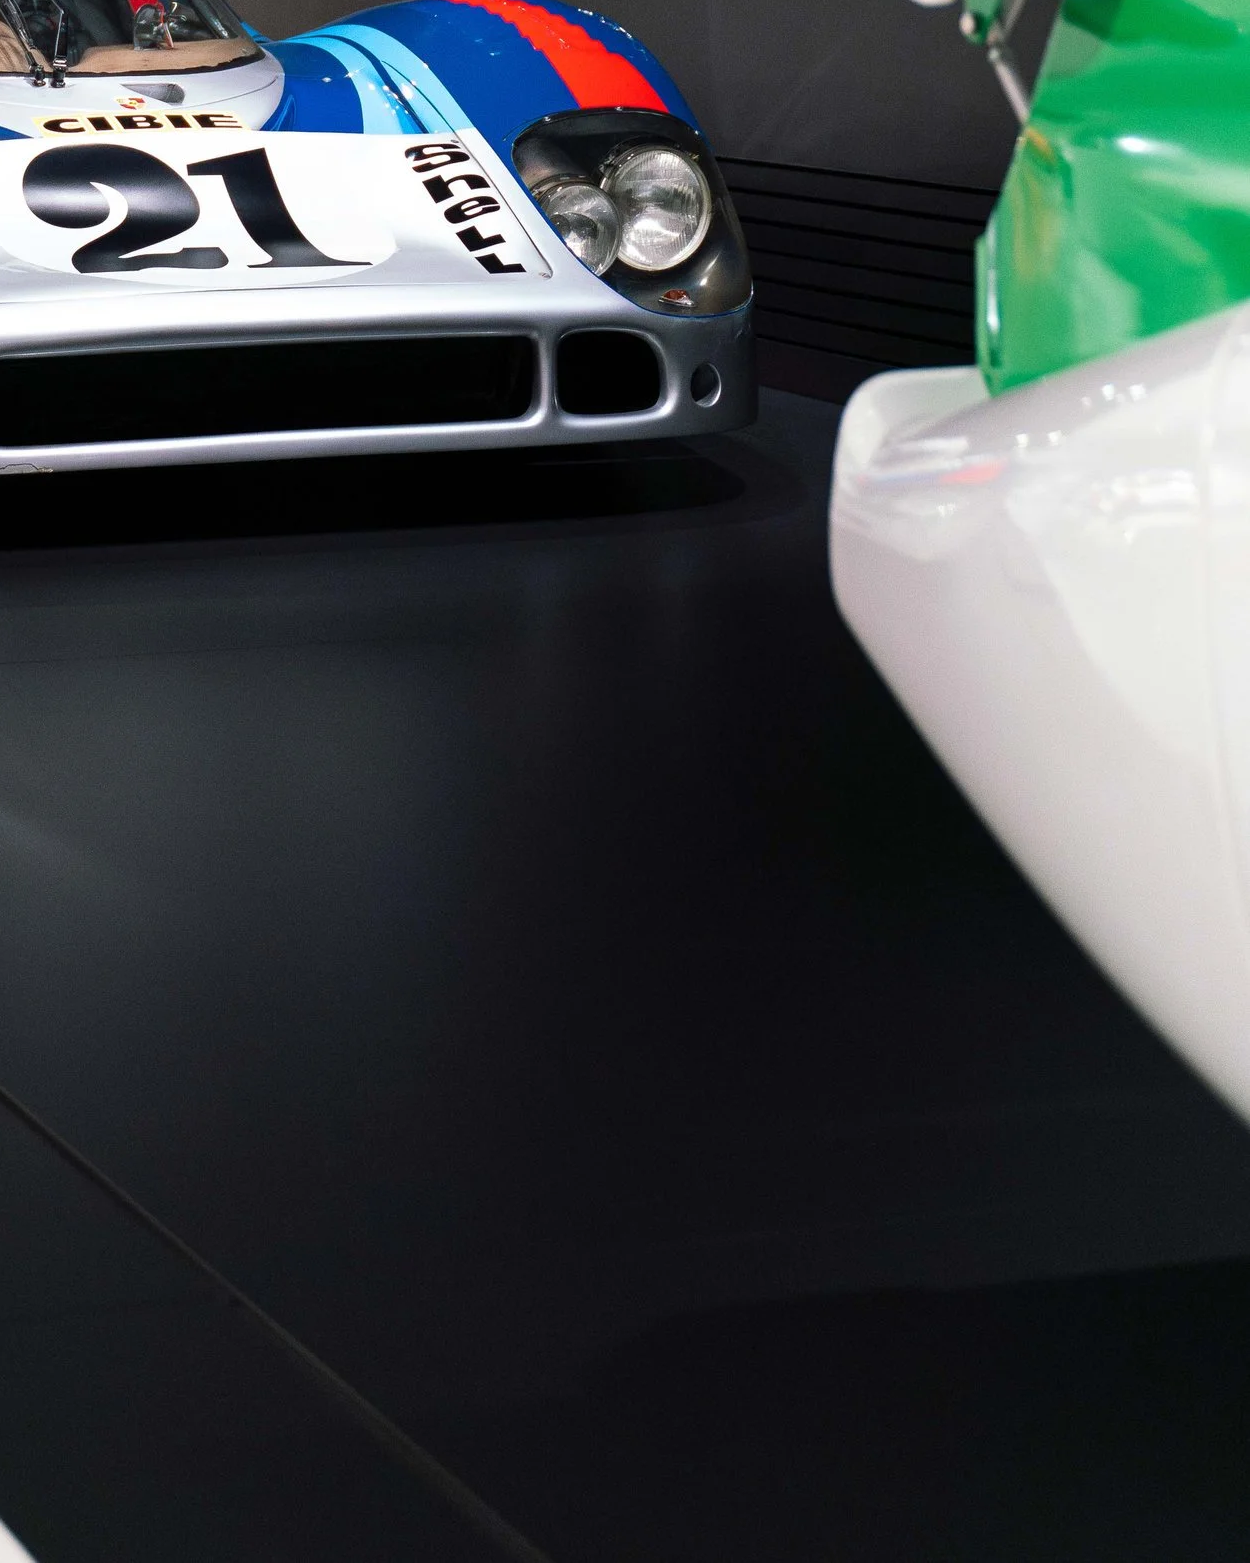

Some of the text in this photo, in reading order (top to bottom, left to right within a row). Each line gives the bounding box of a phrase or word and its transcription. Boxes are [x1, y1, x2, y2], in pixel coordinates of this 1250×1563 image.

[42, 113, 243, 133] CIBIE
[22, 143, 374, 274] 21
[404, 143, 528, 275] Shell
